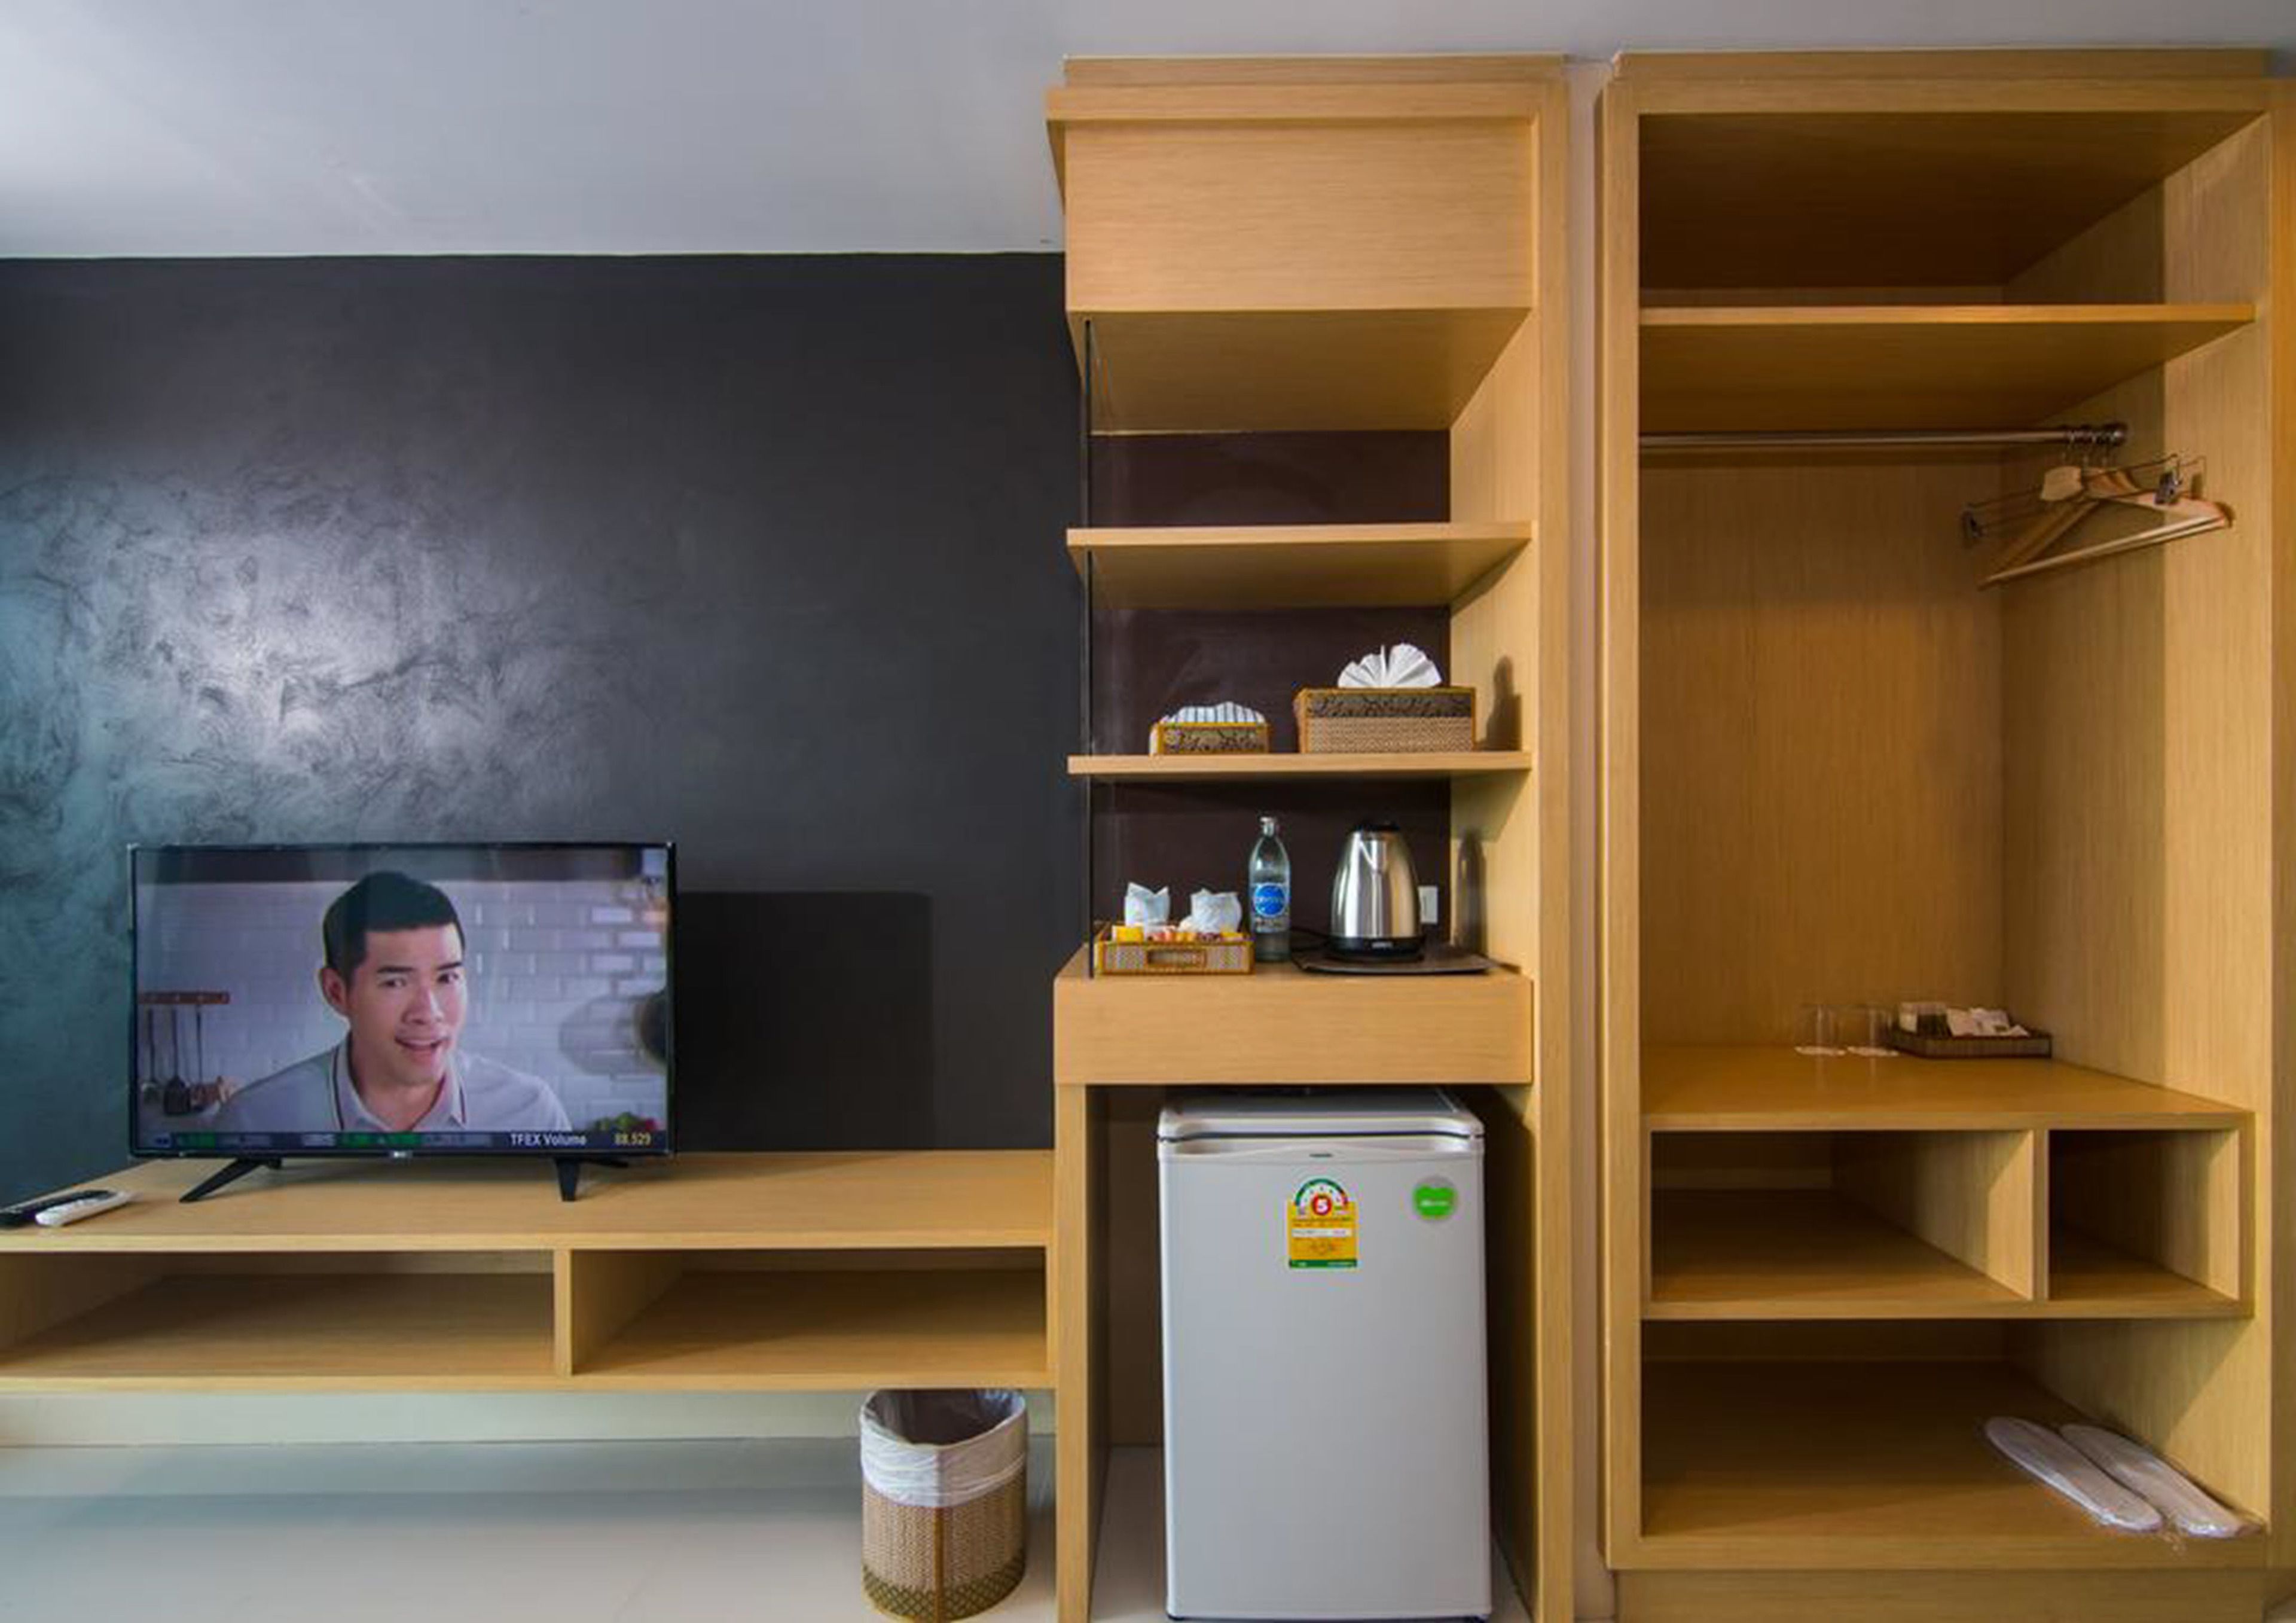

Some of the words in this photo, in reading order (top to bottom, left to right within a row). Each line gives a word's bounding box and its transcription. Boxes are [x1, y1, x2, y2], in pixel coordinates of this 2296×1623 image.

[511, 1133, 541, 1146] TFEX
[542, 1133, 587, 1146] Volume
[1317, 1198, 1328, 1212] 5
